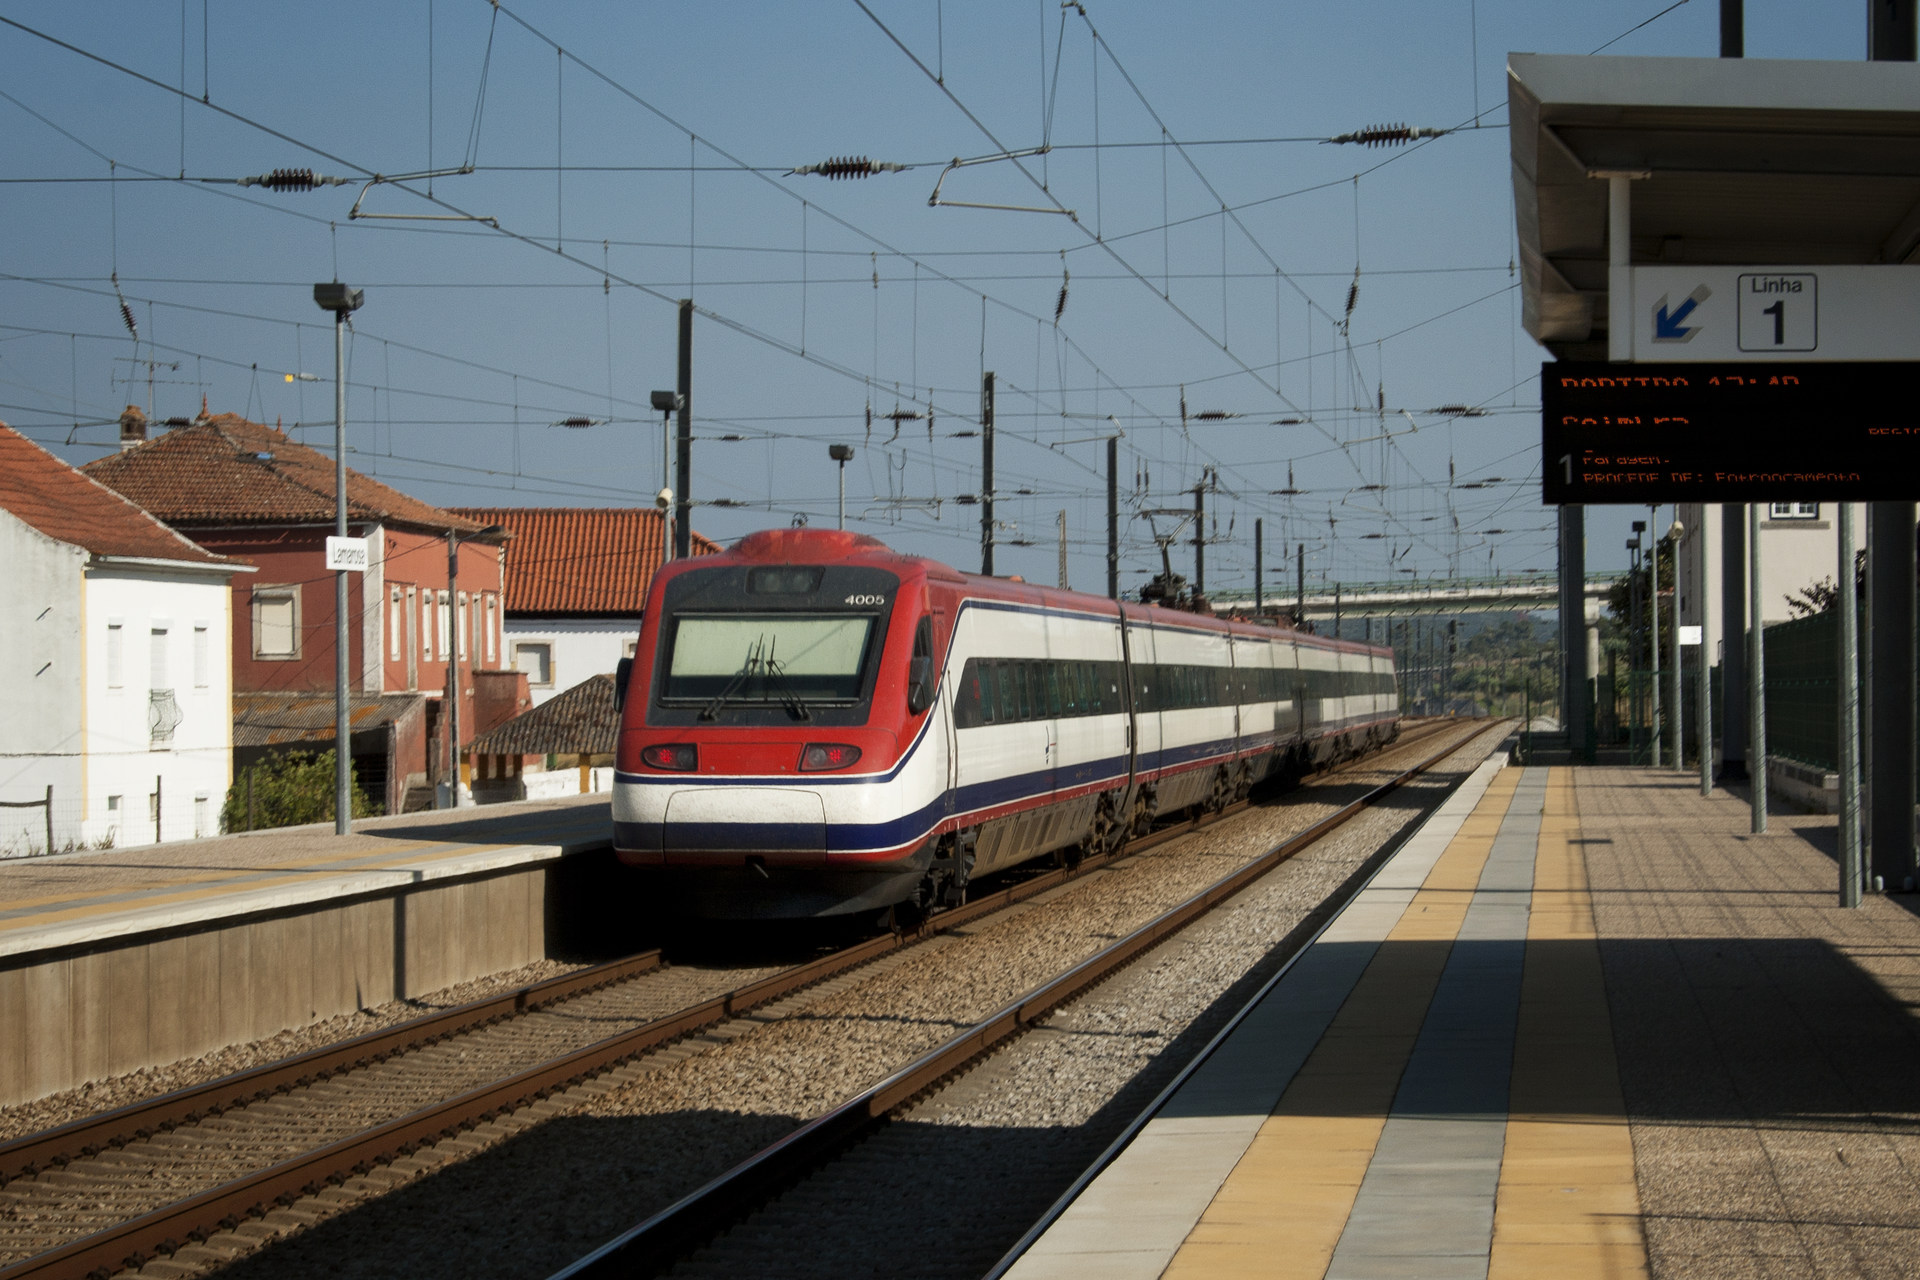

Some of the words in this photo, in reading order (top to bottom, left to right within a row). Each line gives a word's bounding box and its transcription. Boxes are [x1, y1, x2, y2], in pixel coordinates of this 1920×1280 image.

[1752, 277, 1803, 293] Linha
[1763, 300, 1784, 345] 1
[1558, 453, 1573, 485] 1
[844, 595, 885, 605] 4005
